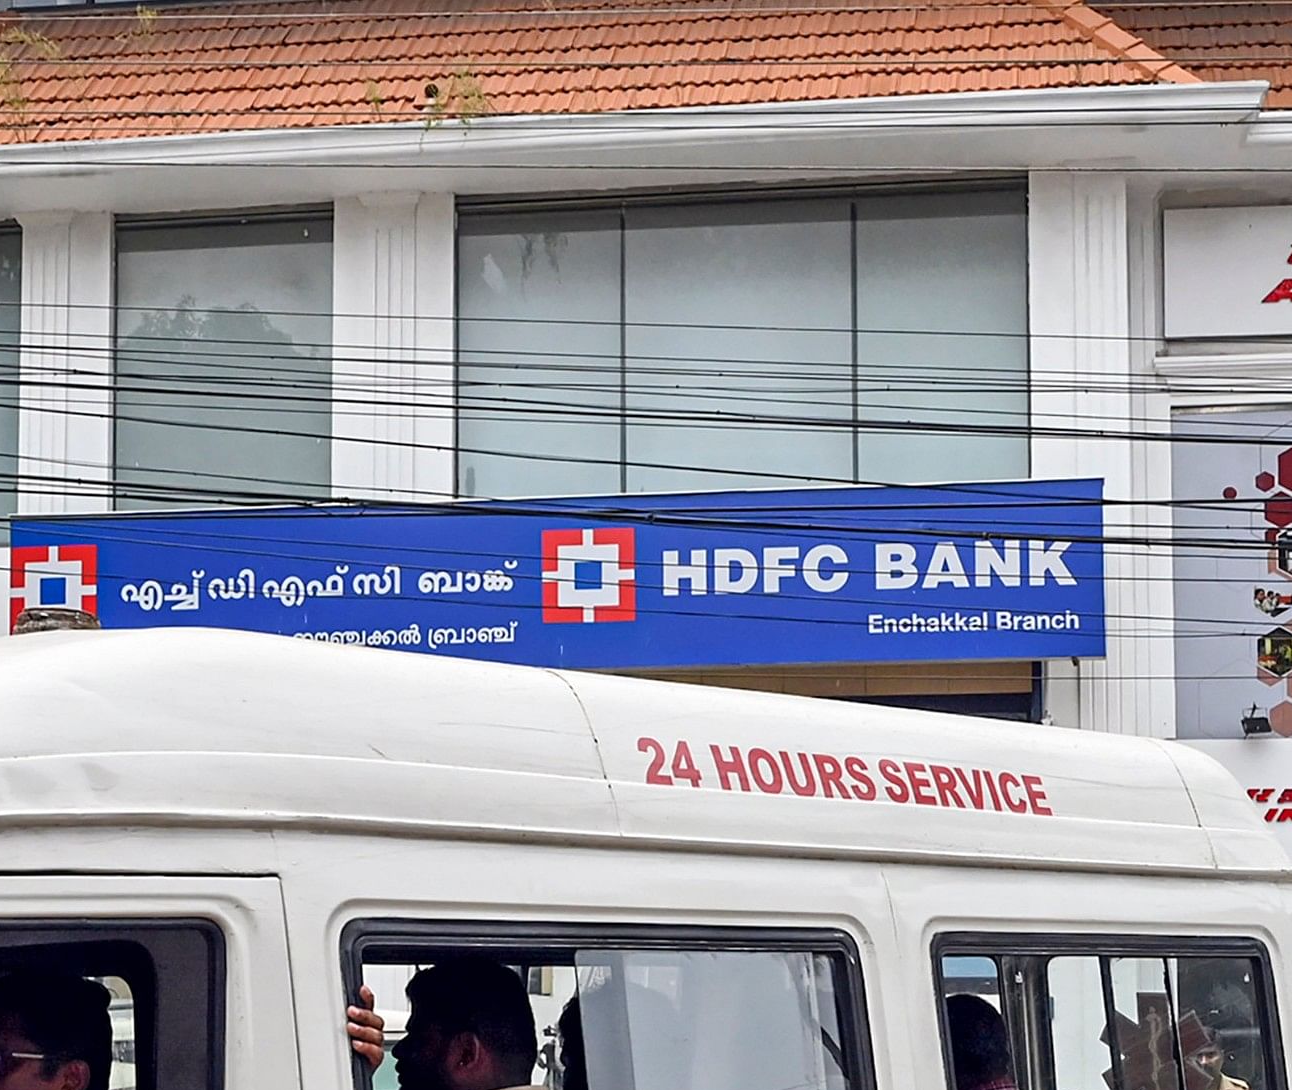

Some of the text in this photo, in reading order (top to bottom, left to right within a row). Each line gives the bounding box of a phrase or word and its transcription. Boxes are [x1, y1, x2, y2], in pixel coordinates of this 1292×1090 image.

[662, 538, 1078, 596] HDFC BANK
[867, 609, 1081, 634] Enchakkal Branch
[636, 736, 1054, 817] 24 HOURS SERVICE
